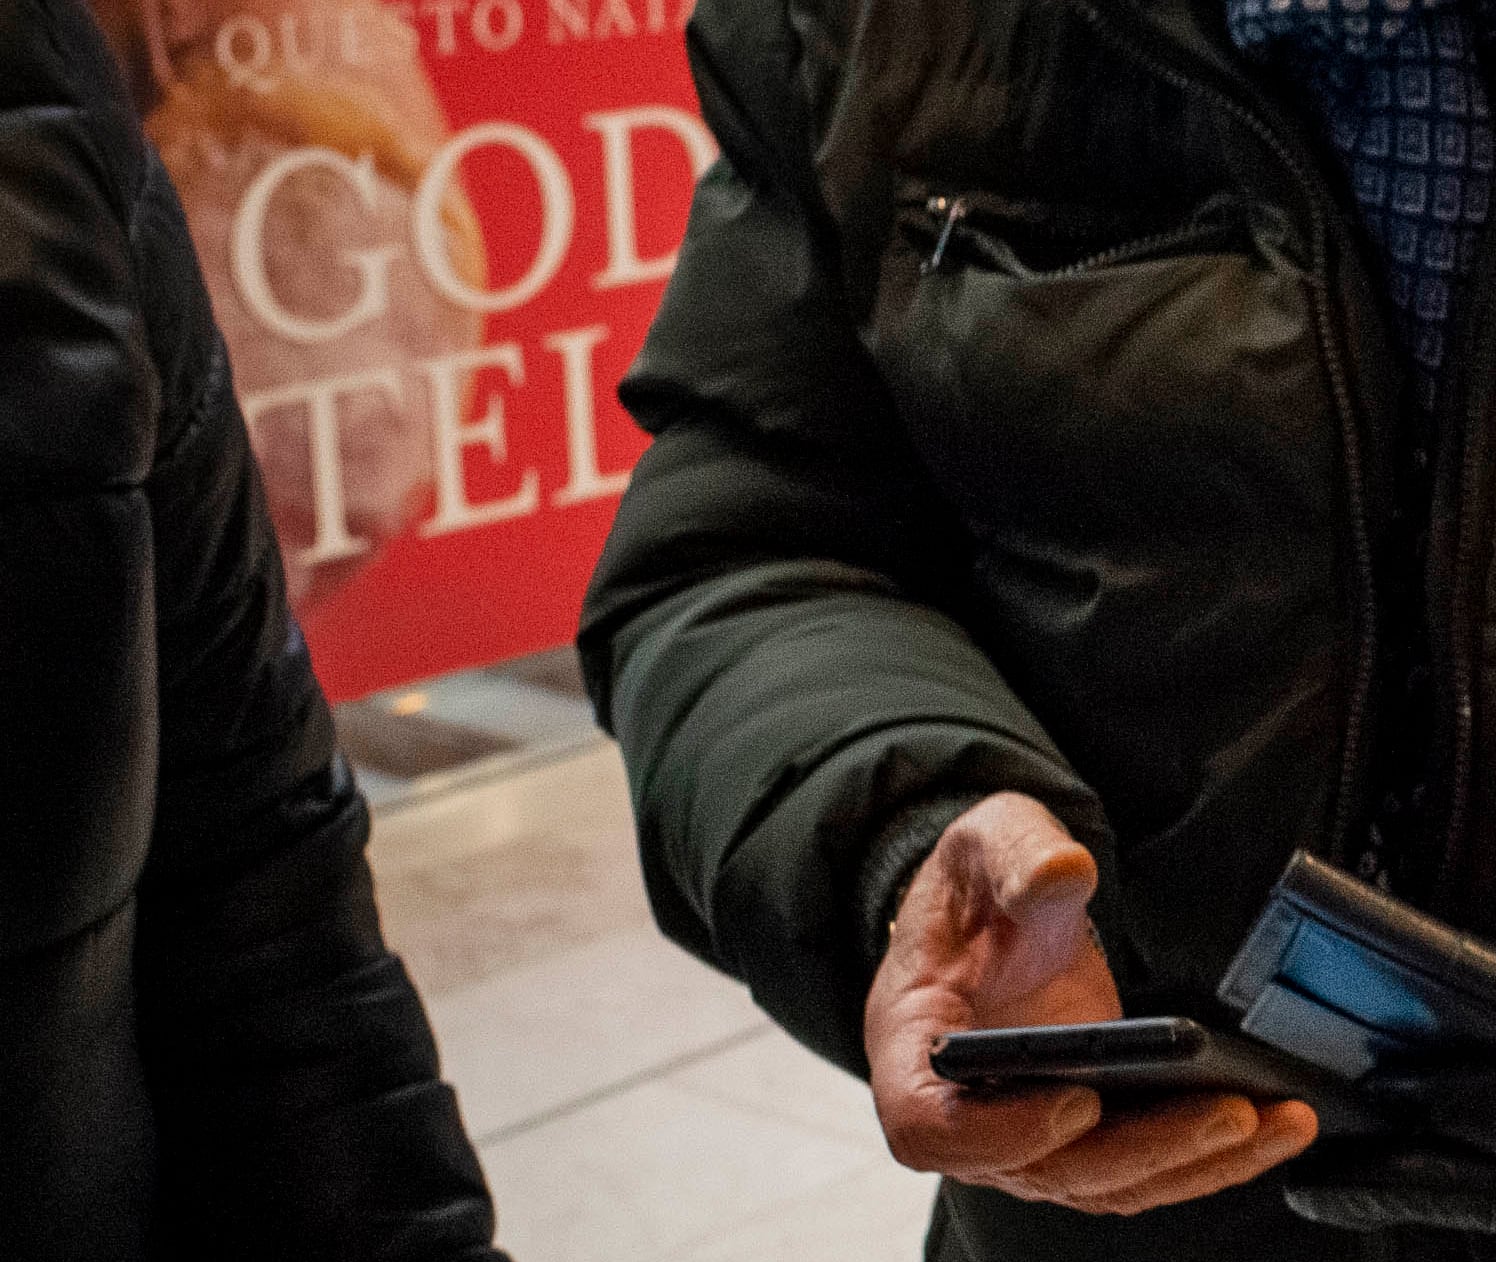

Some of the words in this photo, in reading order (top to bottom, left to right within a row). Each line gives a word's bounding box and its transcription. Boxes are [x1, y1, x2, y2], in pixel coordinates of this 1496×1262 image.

[545, 0, 693, 45] NAT
[232, 106, 718, 341] GOD
[247, 327, 636, 565] TEL
